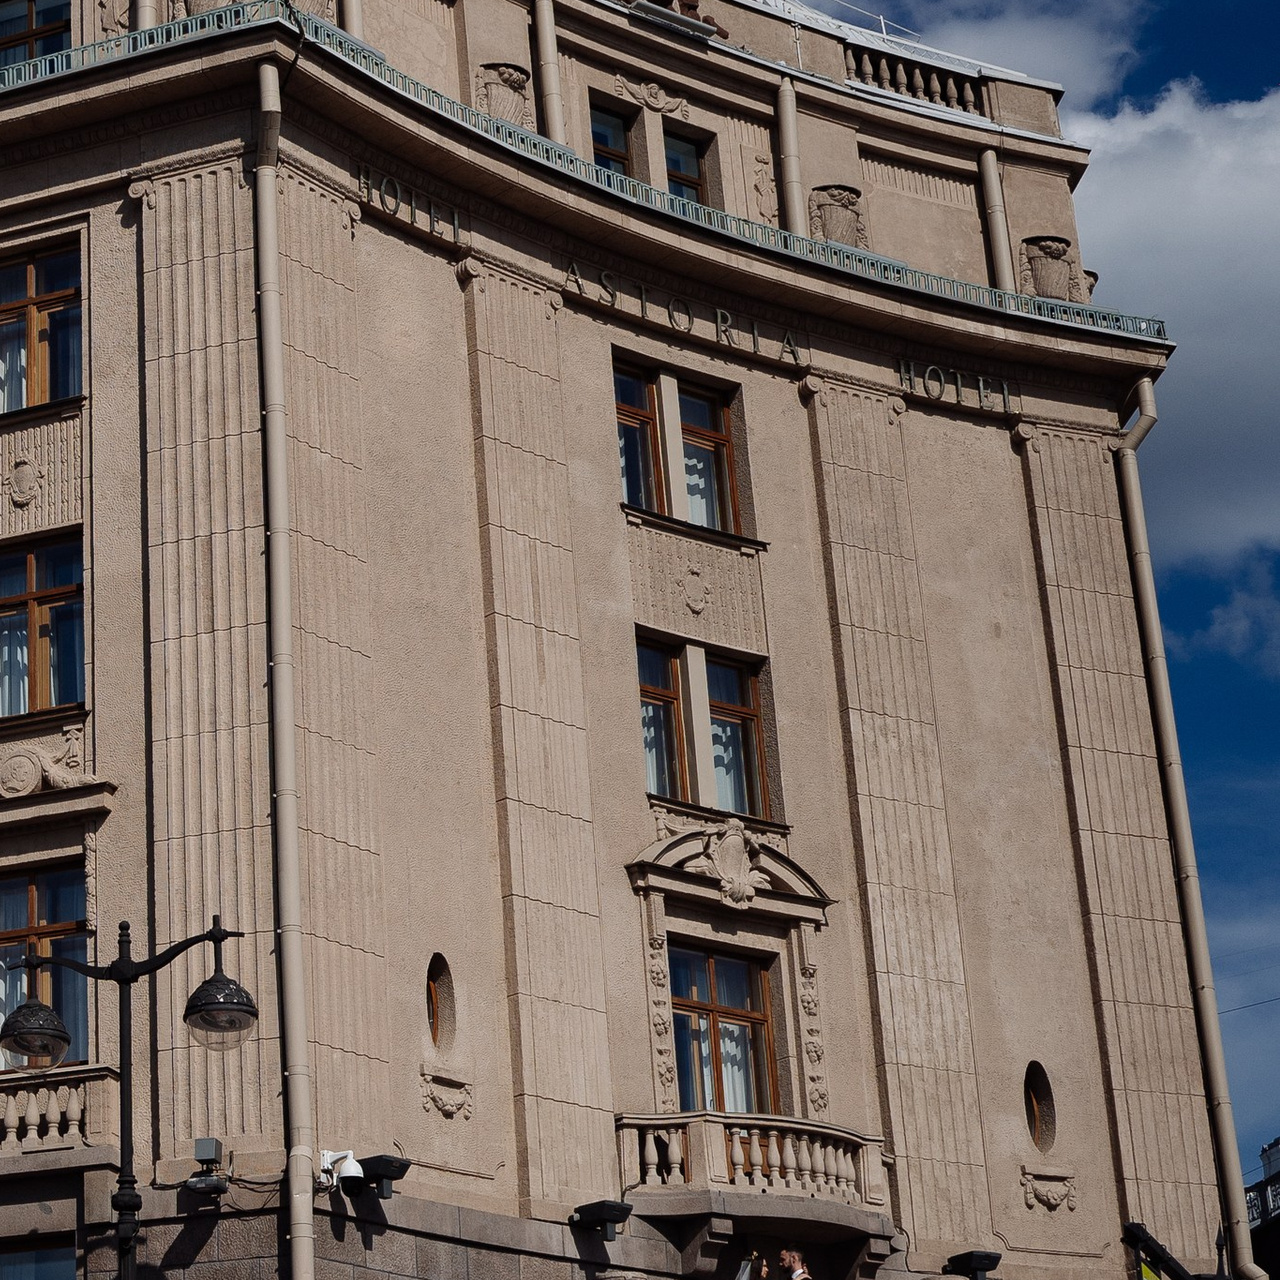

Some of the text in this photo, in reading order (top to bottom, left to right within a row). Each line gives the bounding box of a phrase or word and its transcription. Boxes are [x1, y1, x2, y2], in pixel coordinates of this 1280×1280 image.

[360, 163, 1020, 414] HOTEL ASTORIA HOTEL
